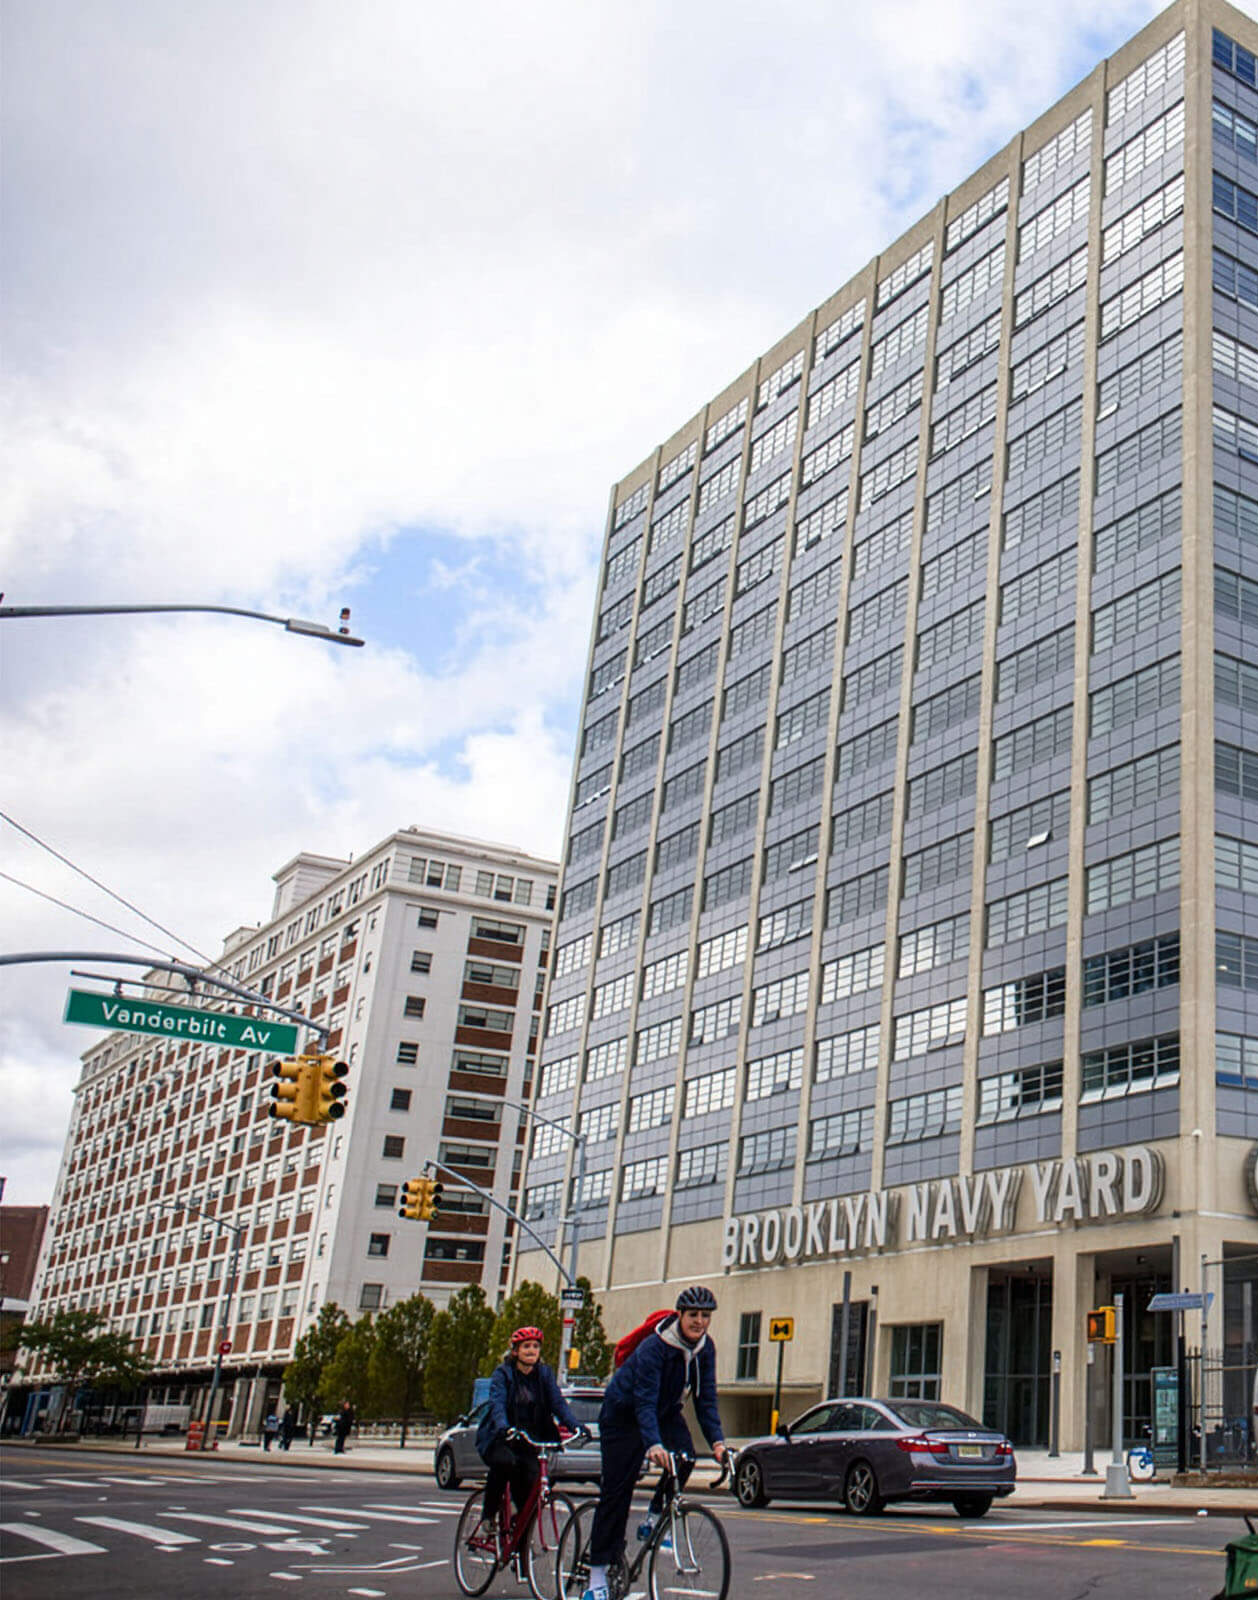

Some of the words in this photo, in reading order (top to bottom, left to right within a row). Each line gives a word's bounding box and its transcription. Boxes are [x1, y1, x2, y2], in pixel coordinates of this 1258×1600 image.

[101, 1001, 227, 1039] Vanderbilt
[239, 1026, 271, 1045] Av
[720, 1189, 889, 1267] BROOKLYN
[905, 1168, 1014, 1242] NAVY
[1030, 1144, 1157, 1223] YARD
